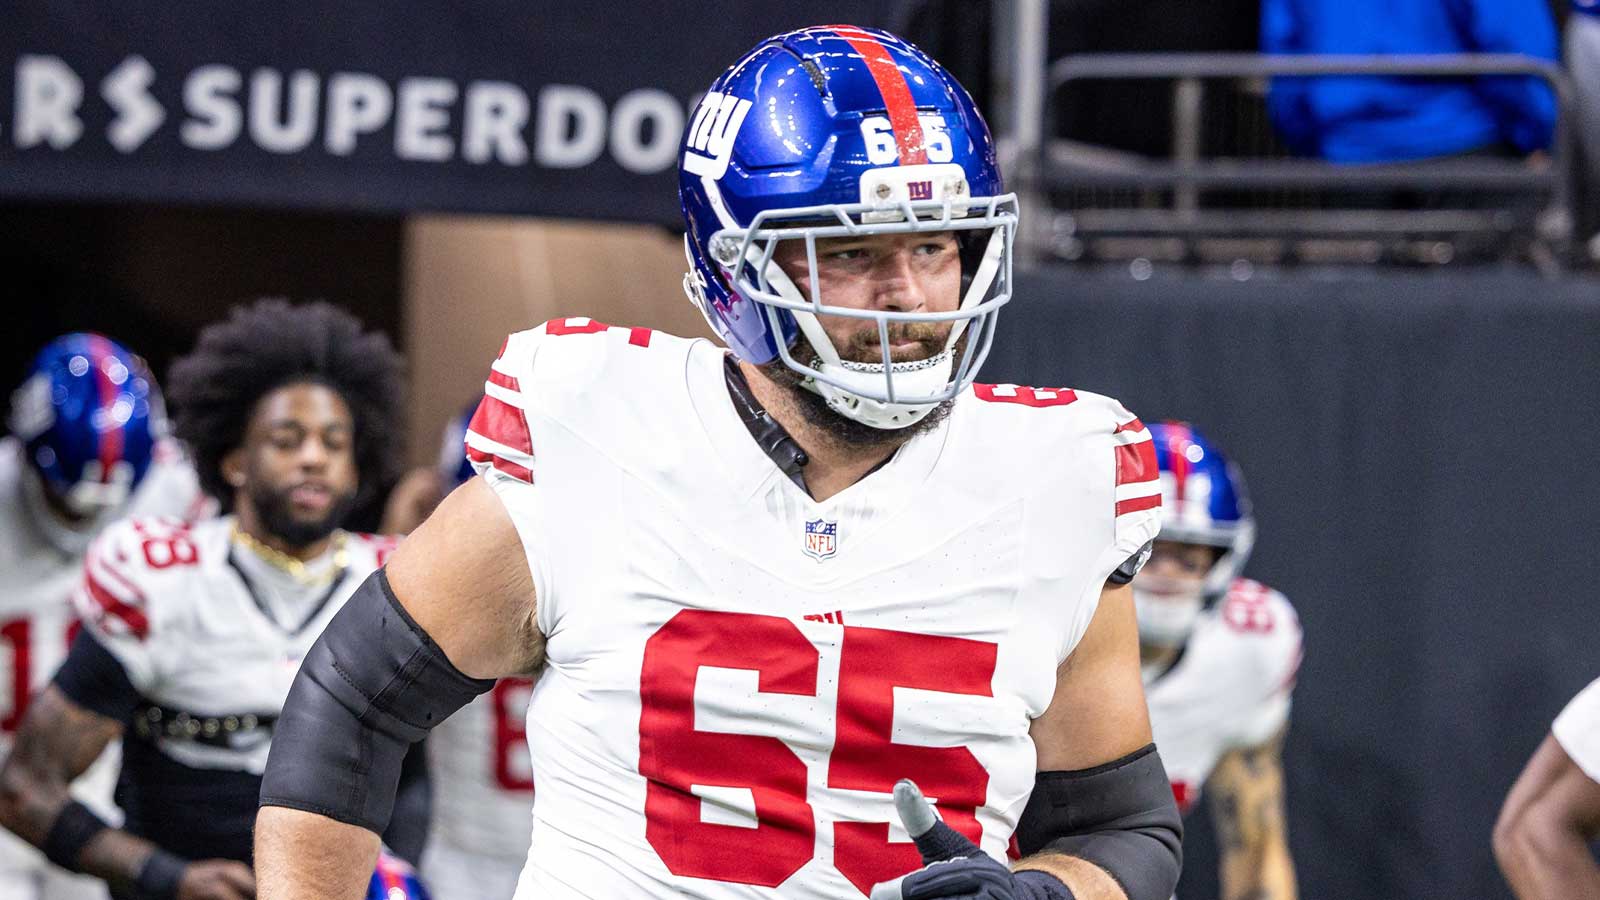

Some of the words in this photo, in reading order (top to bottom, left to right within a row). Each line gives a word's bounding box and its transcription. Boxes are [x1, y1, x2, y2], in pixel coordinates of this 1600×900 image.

[180, 65, 694, 173] SUPERDO
[860, 116, 954, 165] 65
[808, 534, 833, 552] NFL
[638, 608, 998, 898] 65
